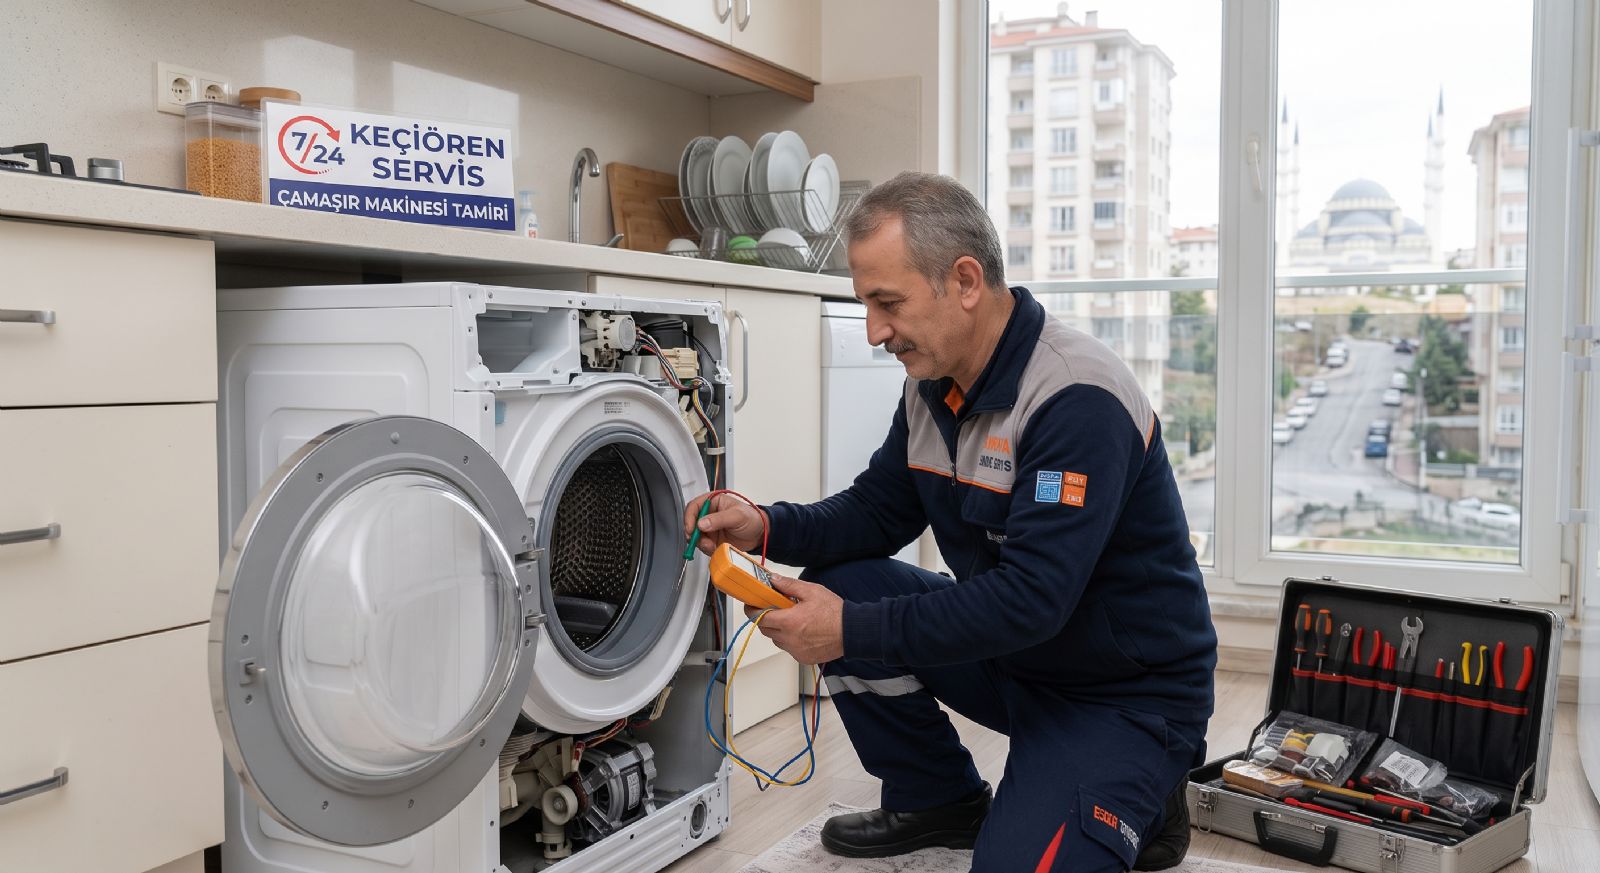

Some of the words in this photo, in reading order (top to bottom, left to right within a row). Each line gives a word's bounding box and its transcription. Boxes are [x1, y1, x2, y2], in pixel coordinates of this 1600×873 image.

[291, 131, 346, 166] 7/24
[350, 123, 505, 160] KEÇİÖREN
[372, 157, 485, 188] SERVİS
[277, 189, 360, 213] ÇAMAŞIR
[365, 196, 448, 217] MAKİNESİ
[452, 202, 509, 222] TAMİRİ
